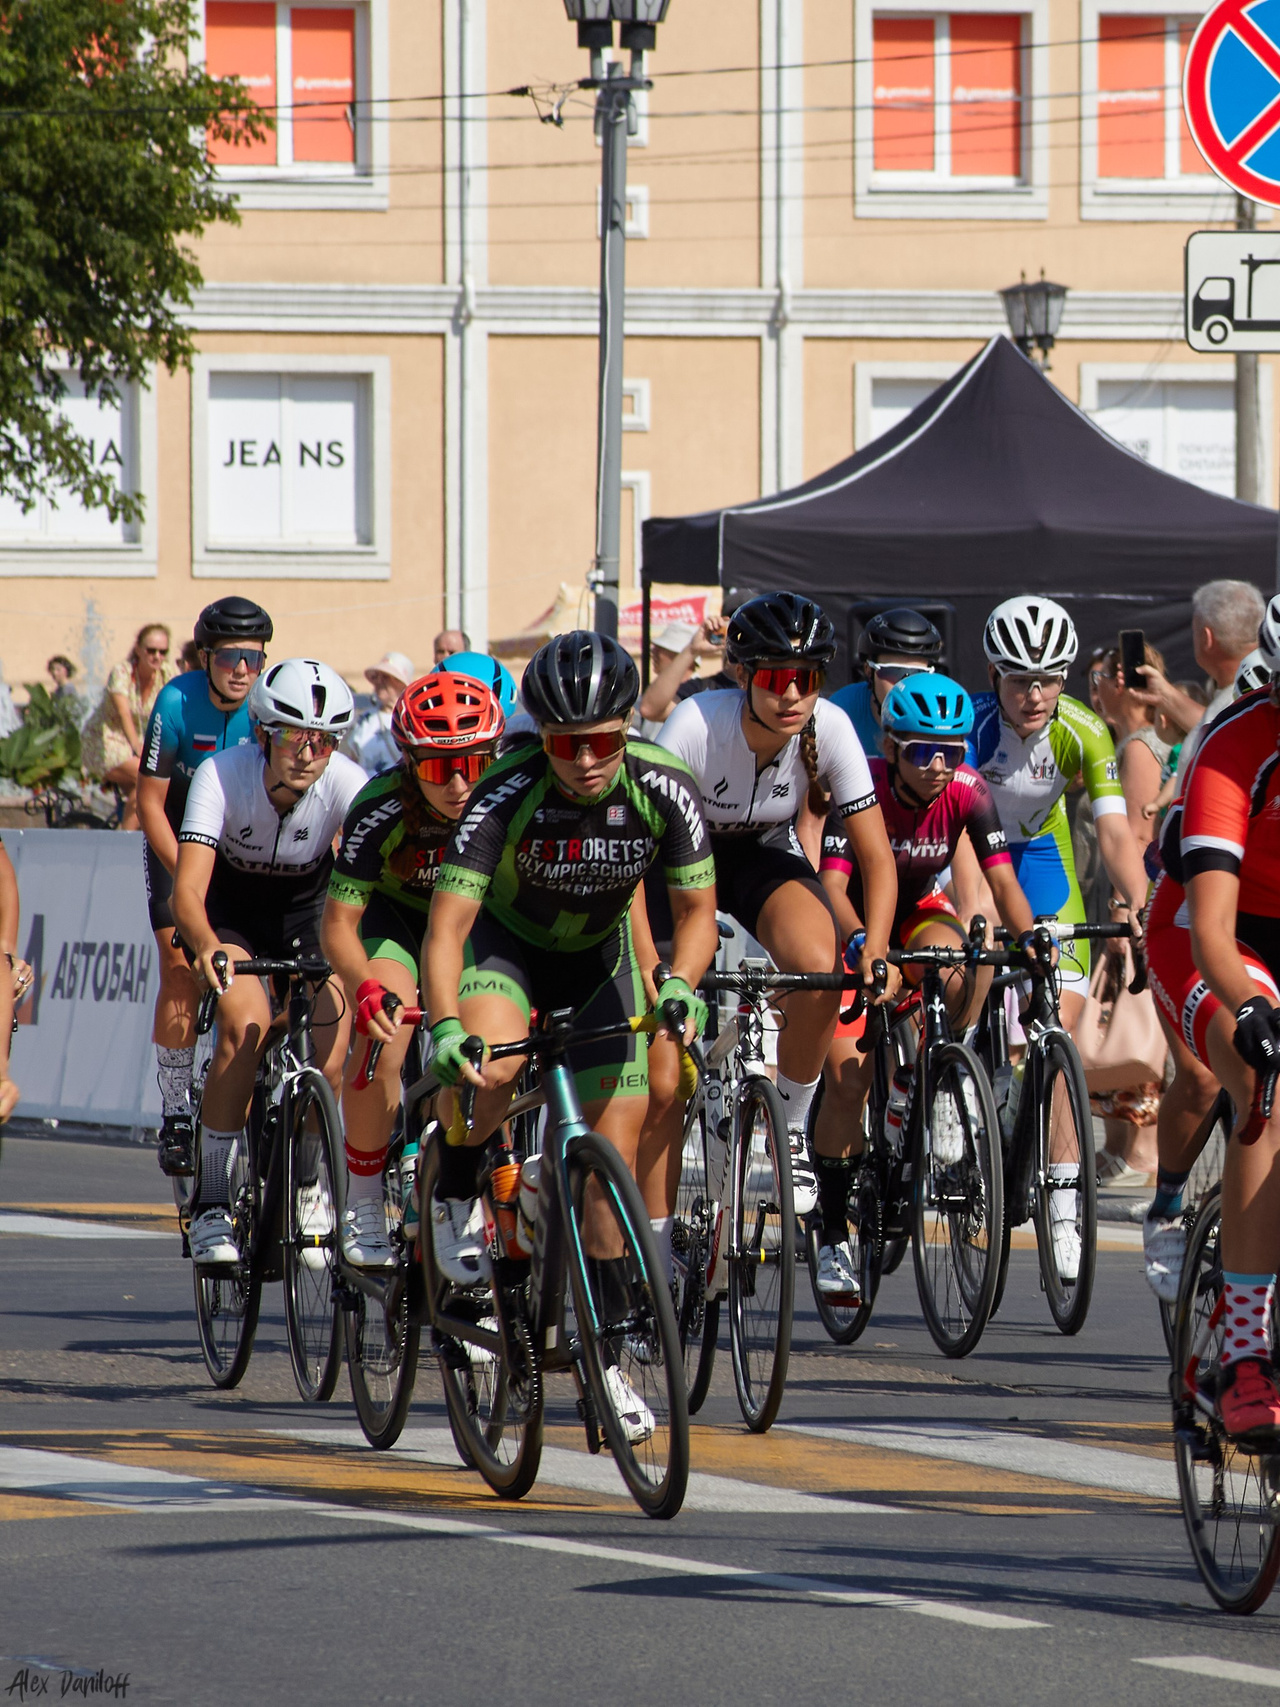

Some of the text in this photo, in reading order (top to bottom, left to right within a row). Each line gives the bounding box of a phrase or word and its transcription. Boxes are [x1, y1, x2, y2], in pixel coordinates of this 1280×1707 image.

[223, 439, 345, 468] JEANS
[146, 712, 163, 772] MAIKOP
[436, 735, 473, 745] SUOMY
[343, 798, 403, 865] MICHE
[453, 772, 532, 855] MICHE
[639, 769, 705, 852] MICHE
[824, 835, 848, 848] BV
[50, 940, 151, 1004] АВТОБАН
